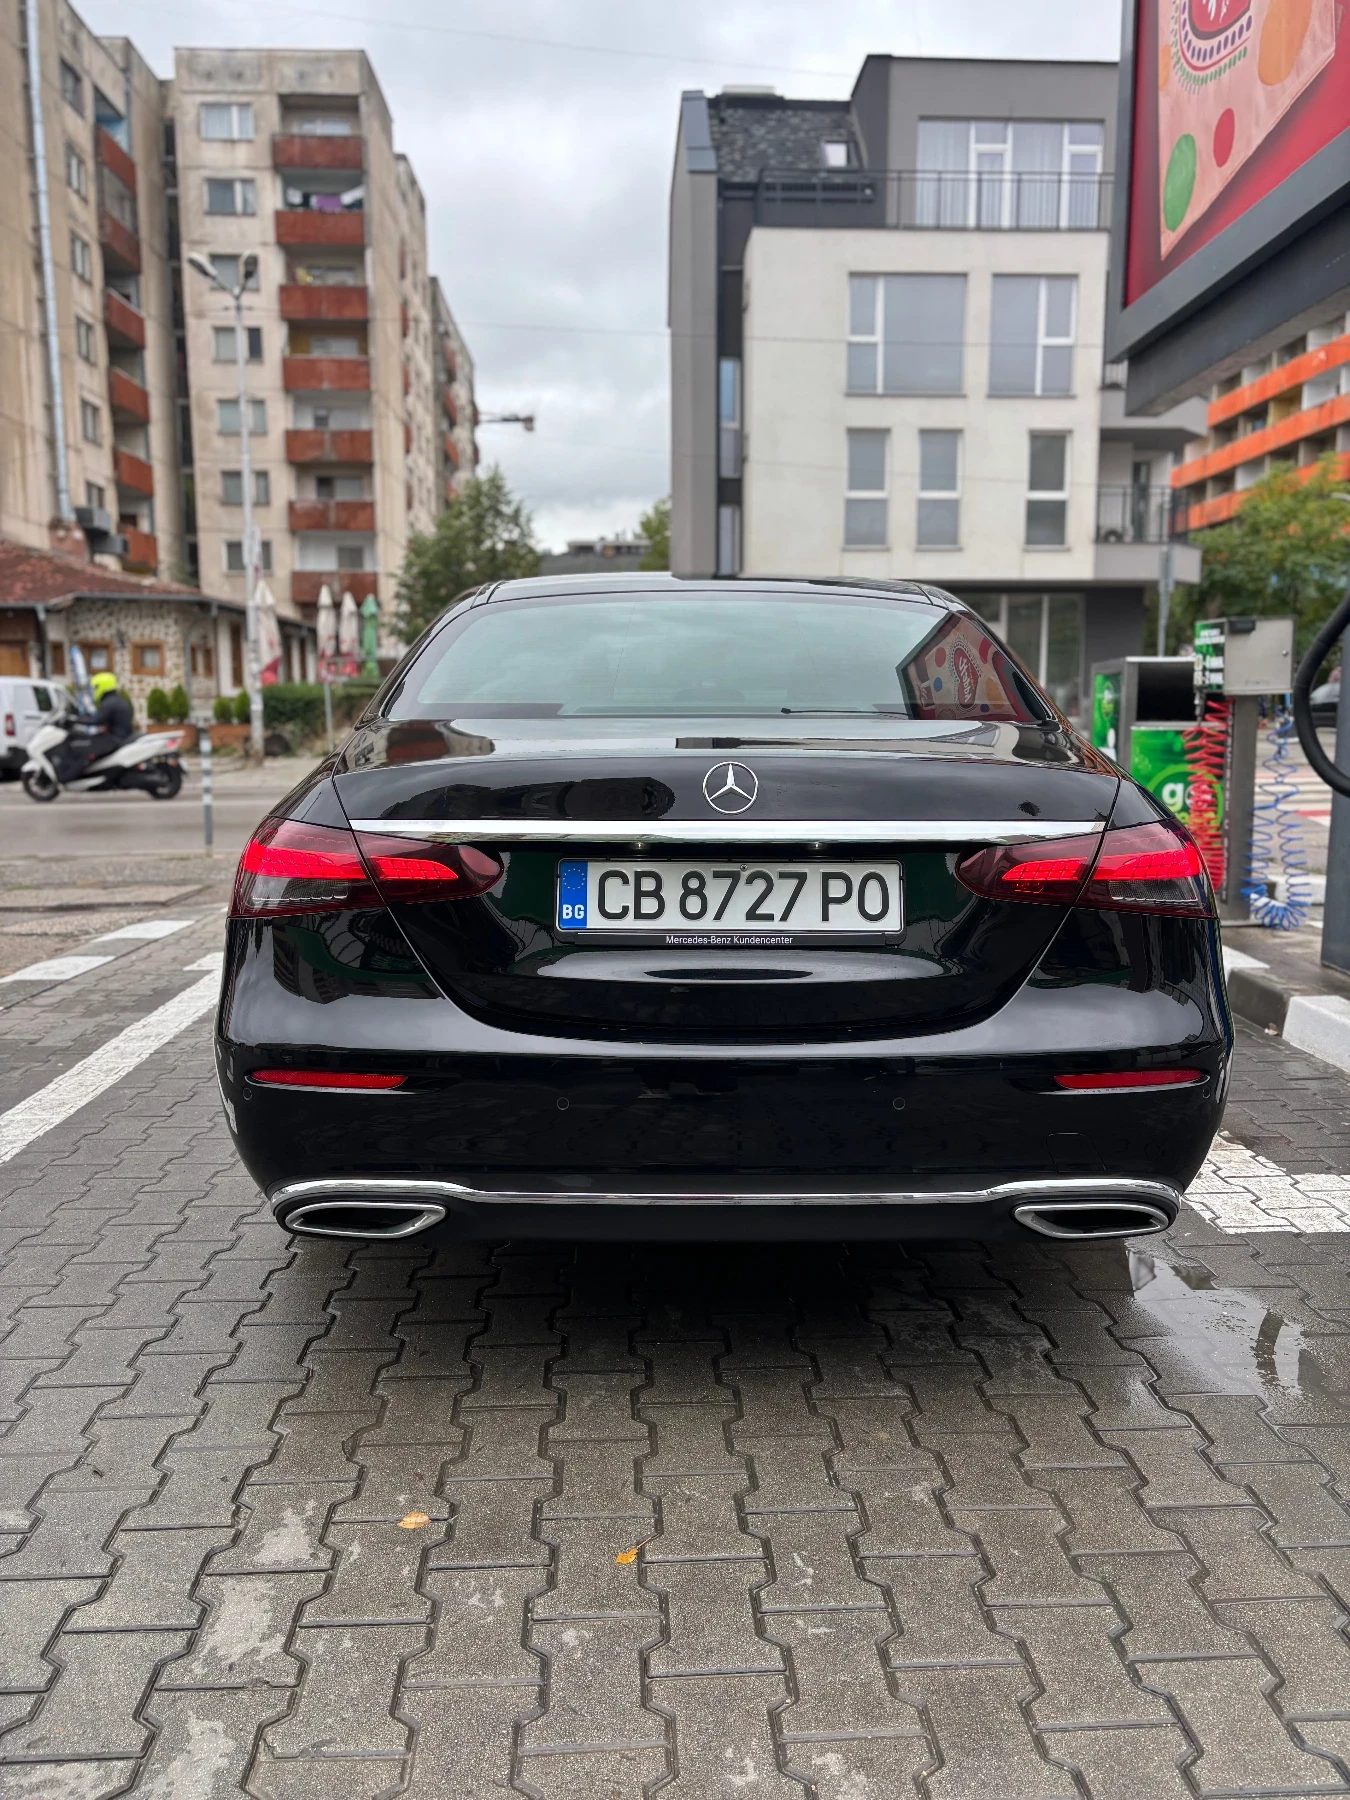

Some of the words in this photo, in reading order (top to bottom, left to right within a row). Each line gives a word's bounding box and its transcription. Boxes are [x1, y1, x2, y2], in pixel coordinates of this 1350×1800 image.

[597, 870, 666, 921] CB
[679, 871, 808, 922] 8727
[821, 871, 890, 922] PO
[562, 904, 585, 920] BG
[665, 935, 732, 945] Mercedes-Benz
[733, 935, 793, 945] Kundencenter
